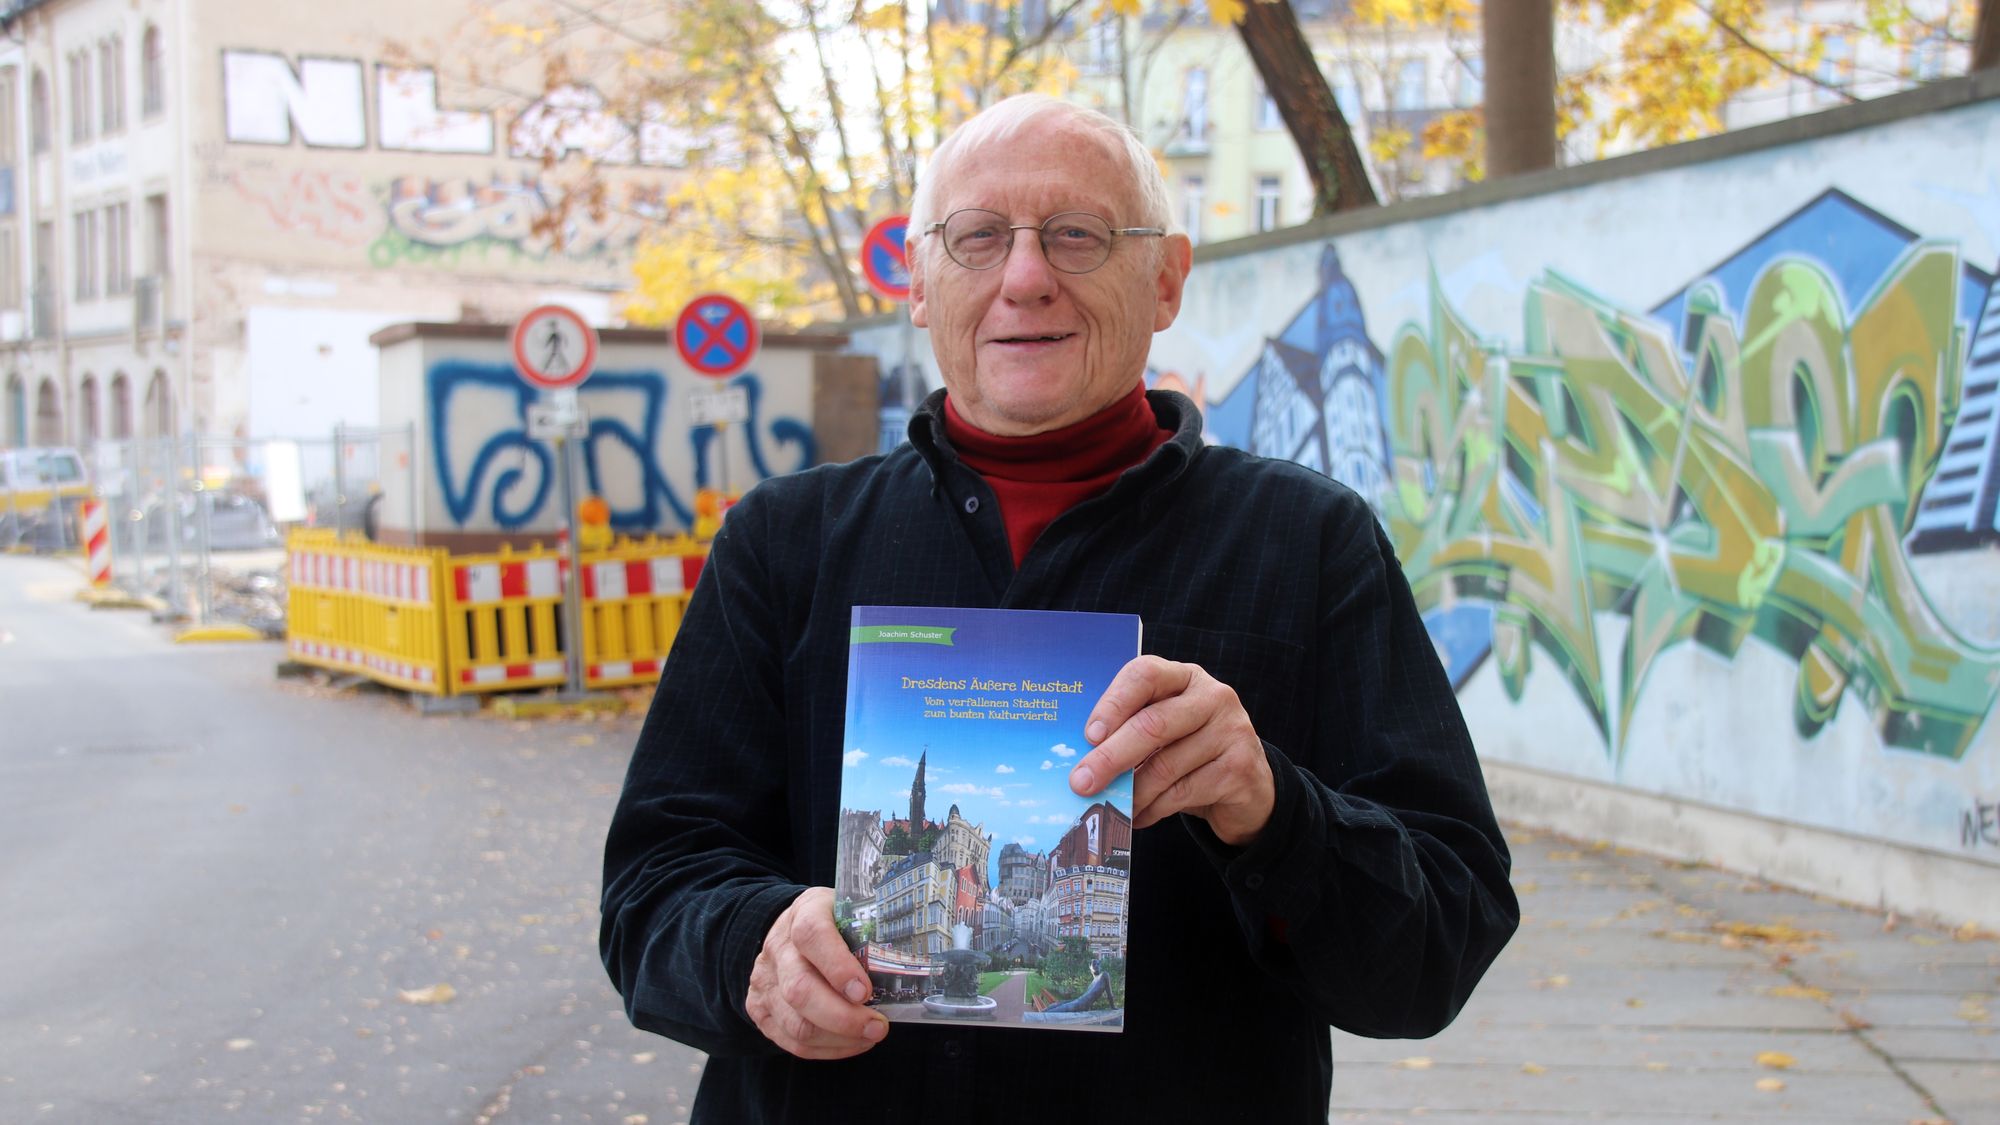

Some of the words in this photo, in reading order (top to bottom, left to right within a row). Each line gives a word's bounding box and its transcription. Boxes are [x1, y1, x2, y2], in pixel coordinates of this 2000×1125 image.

[878, 630, 908, 638] Joachim
[910, 631, 944, 639] Schuster
[901, 676, 966, 691] Dresdens
[970, 676, 1017, 692] Äußere
[1021, 679, 1083, 694] Neustadt
[924, 696, 945, 706] Vom
[948, 697, 1009, 708] verfallenen
[1012, 699, 1059, 709] Stadtteil
[924, 709, 946, 718] zum
[949, 708, 985, 719] bunten
[988, 710, 1058, 721] Kulturviertel
